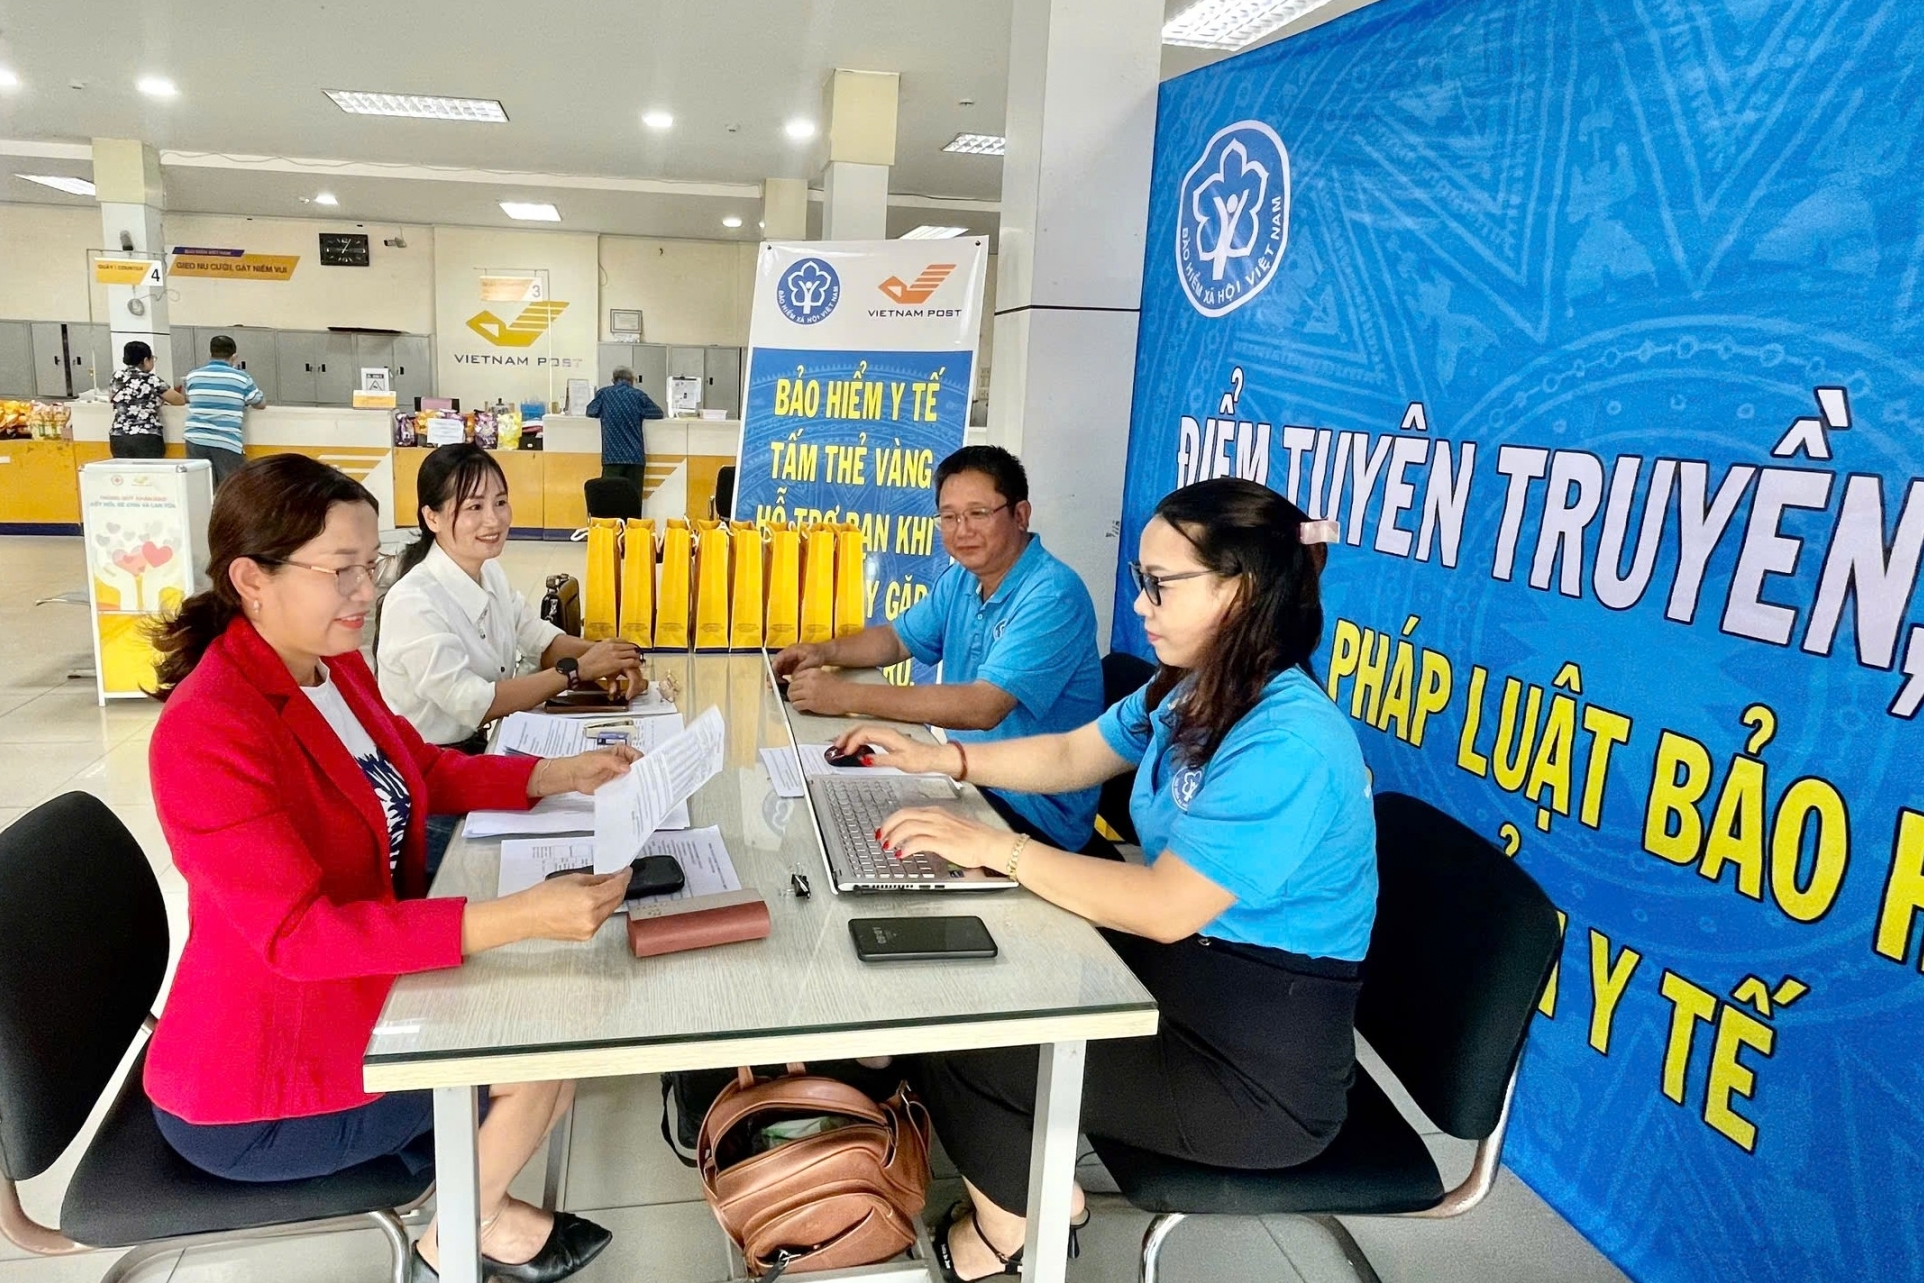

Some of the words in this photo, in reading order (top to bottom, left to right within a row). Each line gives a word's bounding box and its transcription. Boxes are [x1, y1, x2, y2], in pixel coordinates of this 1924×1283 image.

[151, 268, 160, 282] 4
[1217, 280, 1241, 304] HỘI
[1245, 243, 1274, 286] VIỆT
[1271, 196, 1282, 240] NAM
[532, 284, 541, 298] 3
[868, 309, 923, 317] VIETNAM
[927, 309, 962, 317] POST
[454, 354, 528, 366] VIETNAM
[537, 356, 583, 368] POST
[774, 365, 820, 418] BẢO
[826, 361, 883, 420] HIỂM
[891, 382, 906, 421] Y
[912, 367, 946, 422] TẾ
[770, 428, 819, 482] TẤM
[825, 432, 868, 485] THẺ
[876, 438, 934, 489] VÀNG
[1177, 367, 1272, 490] ĐIỂM
[1283, 403, 1476, 568] TUYÊN
[895, 515, 934, 556] KHI
[1327, 615, 1453, 747] PHÁP
[1457, 662, 1633, 832] LUẬT
[1643, 703, 1850, 923] BẢO
[1589, 929, 1641, 1056] Y
[1660, 970, 1810, 1154] TẾ
